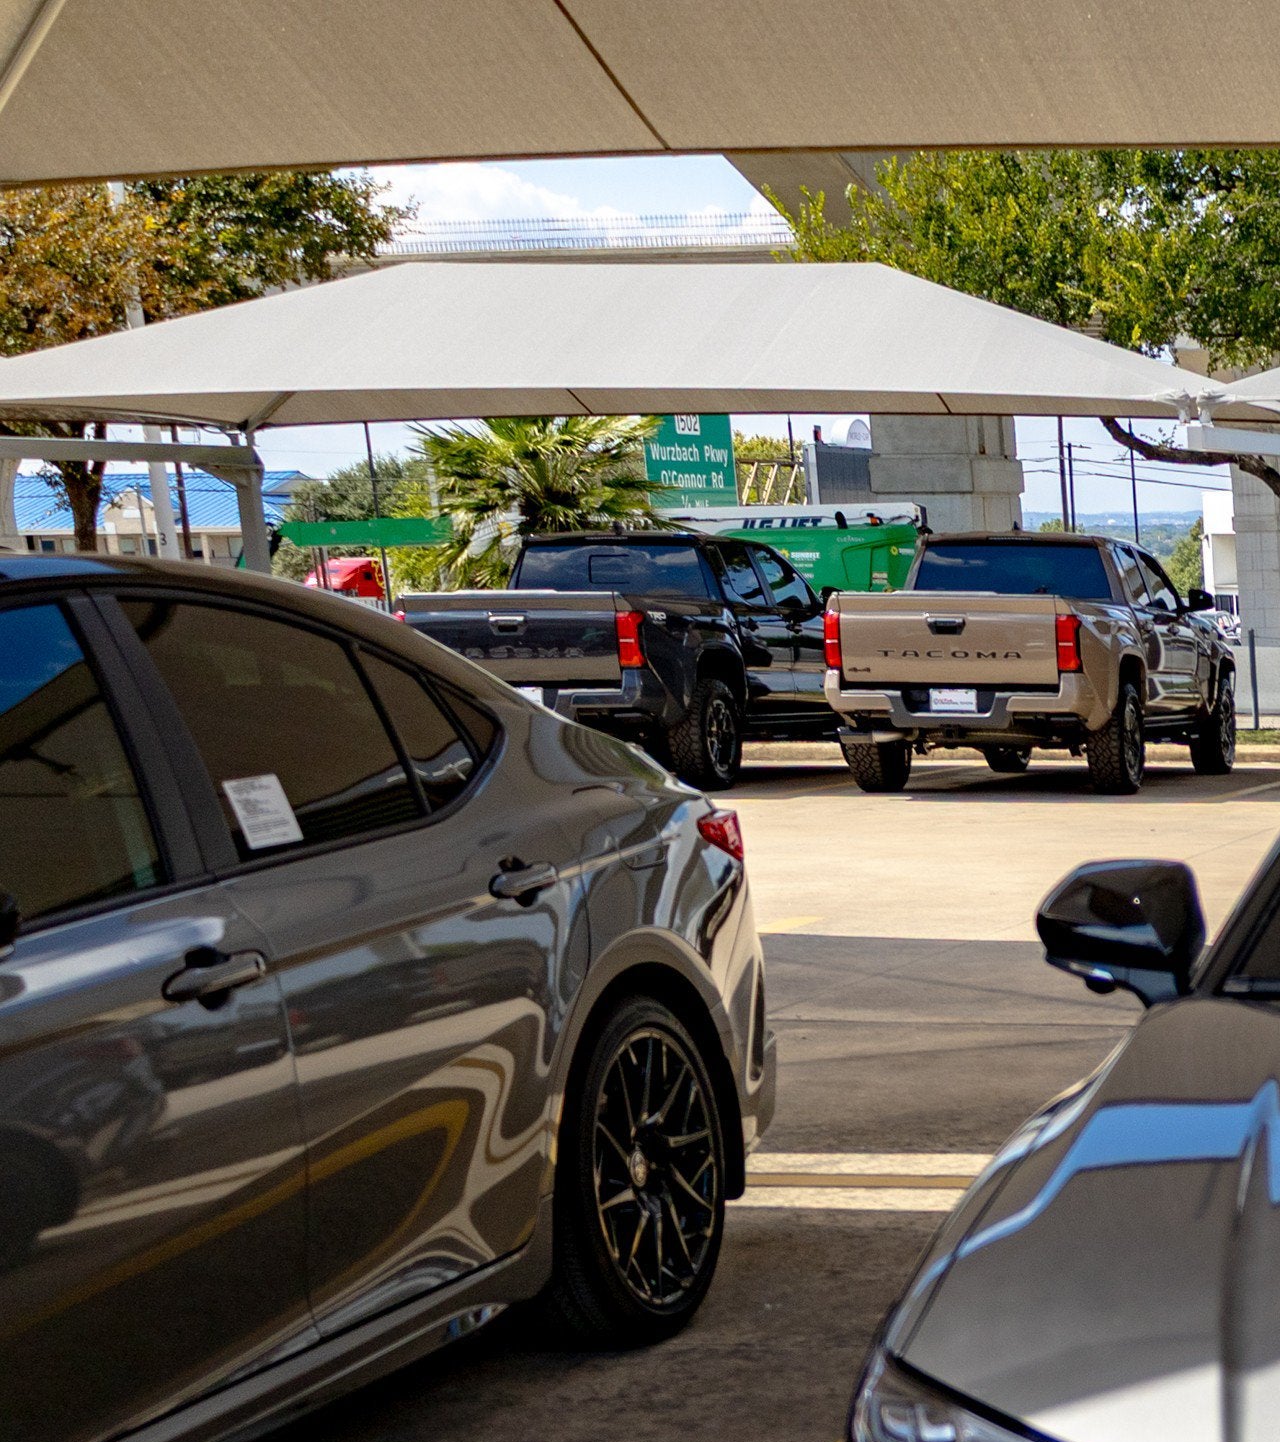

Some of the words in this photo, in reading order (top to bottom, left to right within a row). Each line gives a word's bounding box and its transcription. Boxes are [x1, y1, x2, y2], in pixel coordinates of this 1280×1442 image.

[650, 443, 700, 462] Wurzbach
[704, 444, 728, 468] Pkwy
[661, 470, 706, 489] O'Connor
[712, 471, 724, 489] Rd
[876, 649, 1022, 660] TACOMA
